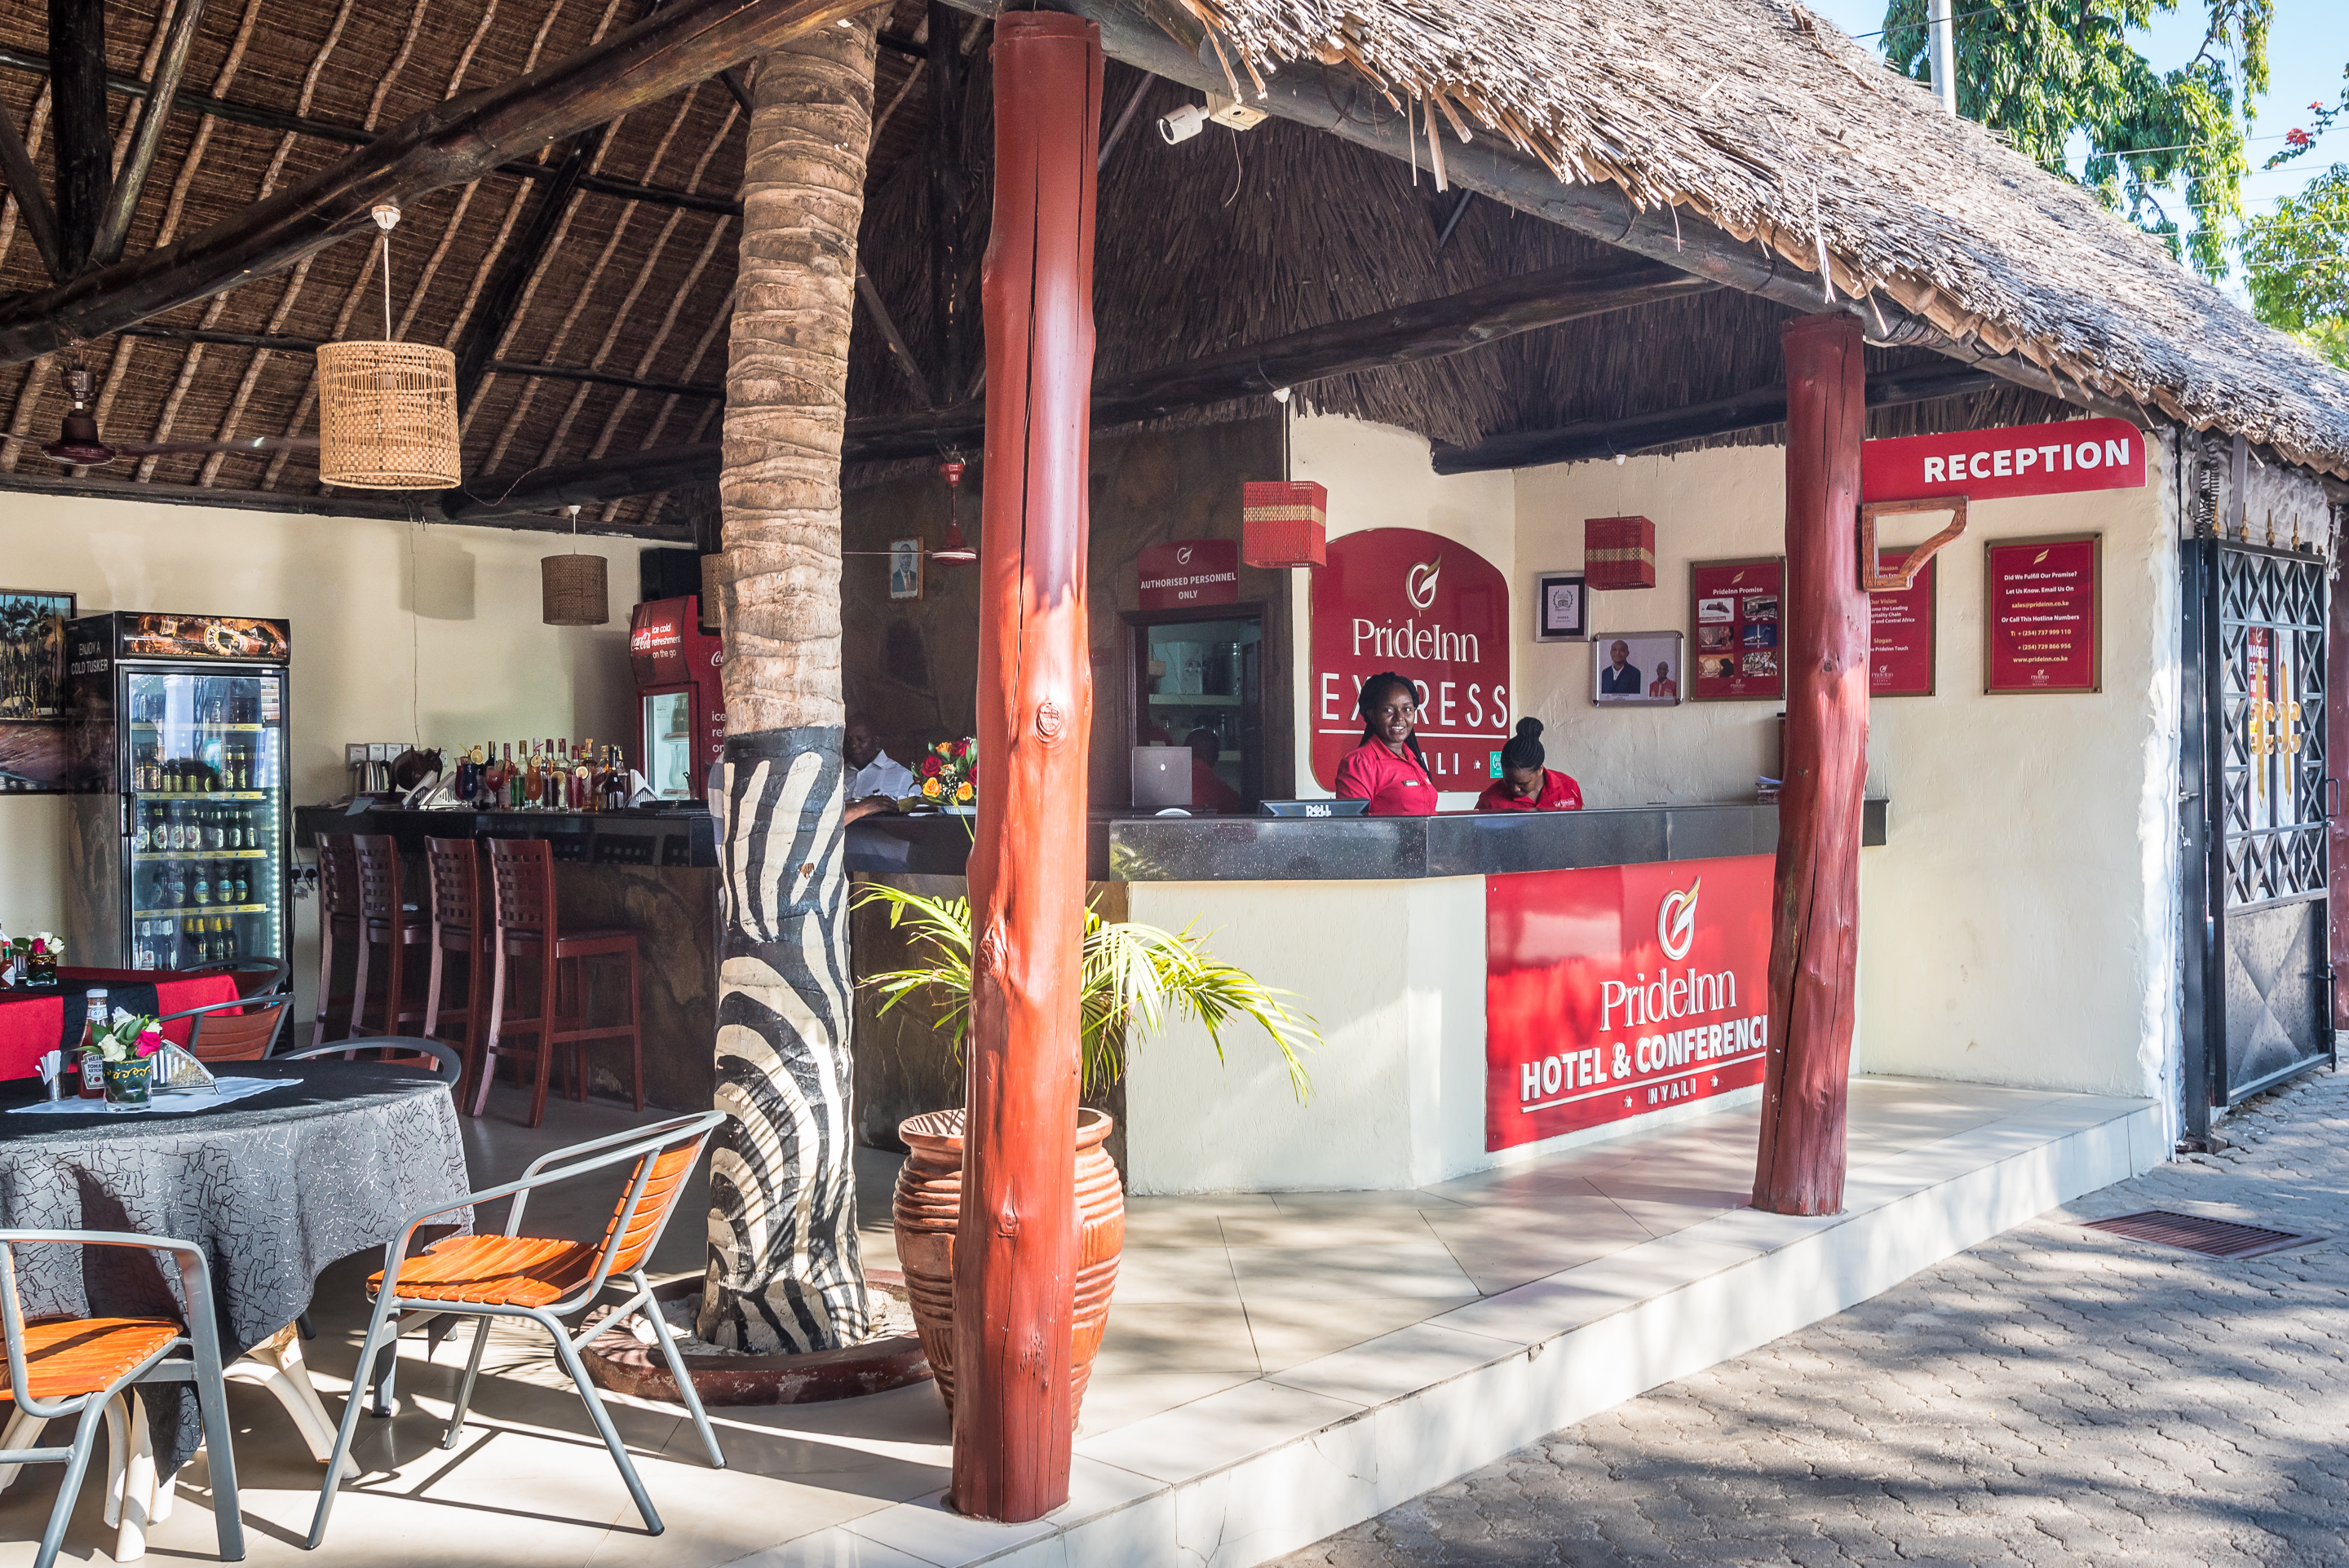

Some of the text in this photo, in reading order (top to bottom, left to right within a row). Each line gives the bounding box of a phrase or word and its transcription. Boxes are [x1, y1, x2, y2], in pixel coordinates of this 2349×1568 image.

[1924, 438, 2130, 483] RECEPTION
[1140, 572, 1236, 589] AUTHORISED PERSONNEL
[1178, 590, 1197, 599] ONLY
[2011, 600, 2069, 608] sales@prideinn.co.ke
[660, 623, 671, 633] cold
[652, 635, 681, 647] refreshment
[1351, 617, 1480, 663] PrideInn
[79, 641, 100, 656] ENJOY A
[660, 650, 668, 658] the
[670, 650, 676, 658] go
[72, 659, 108, 674] COLD TUSKER
[2013, 656, 2068, 664] www.prideinn.co.ke
[1321, 672, 1508, 728] EXRESS
[711, 711, 726, 721] ice
[1599, 967, 1736, 1031] PrideInn
[1520, 1047, 1607, 1102] HOTEL
[1611, 1042, 1630, 1080] &
[1648, 1078, 1696, 1104] NYALI
